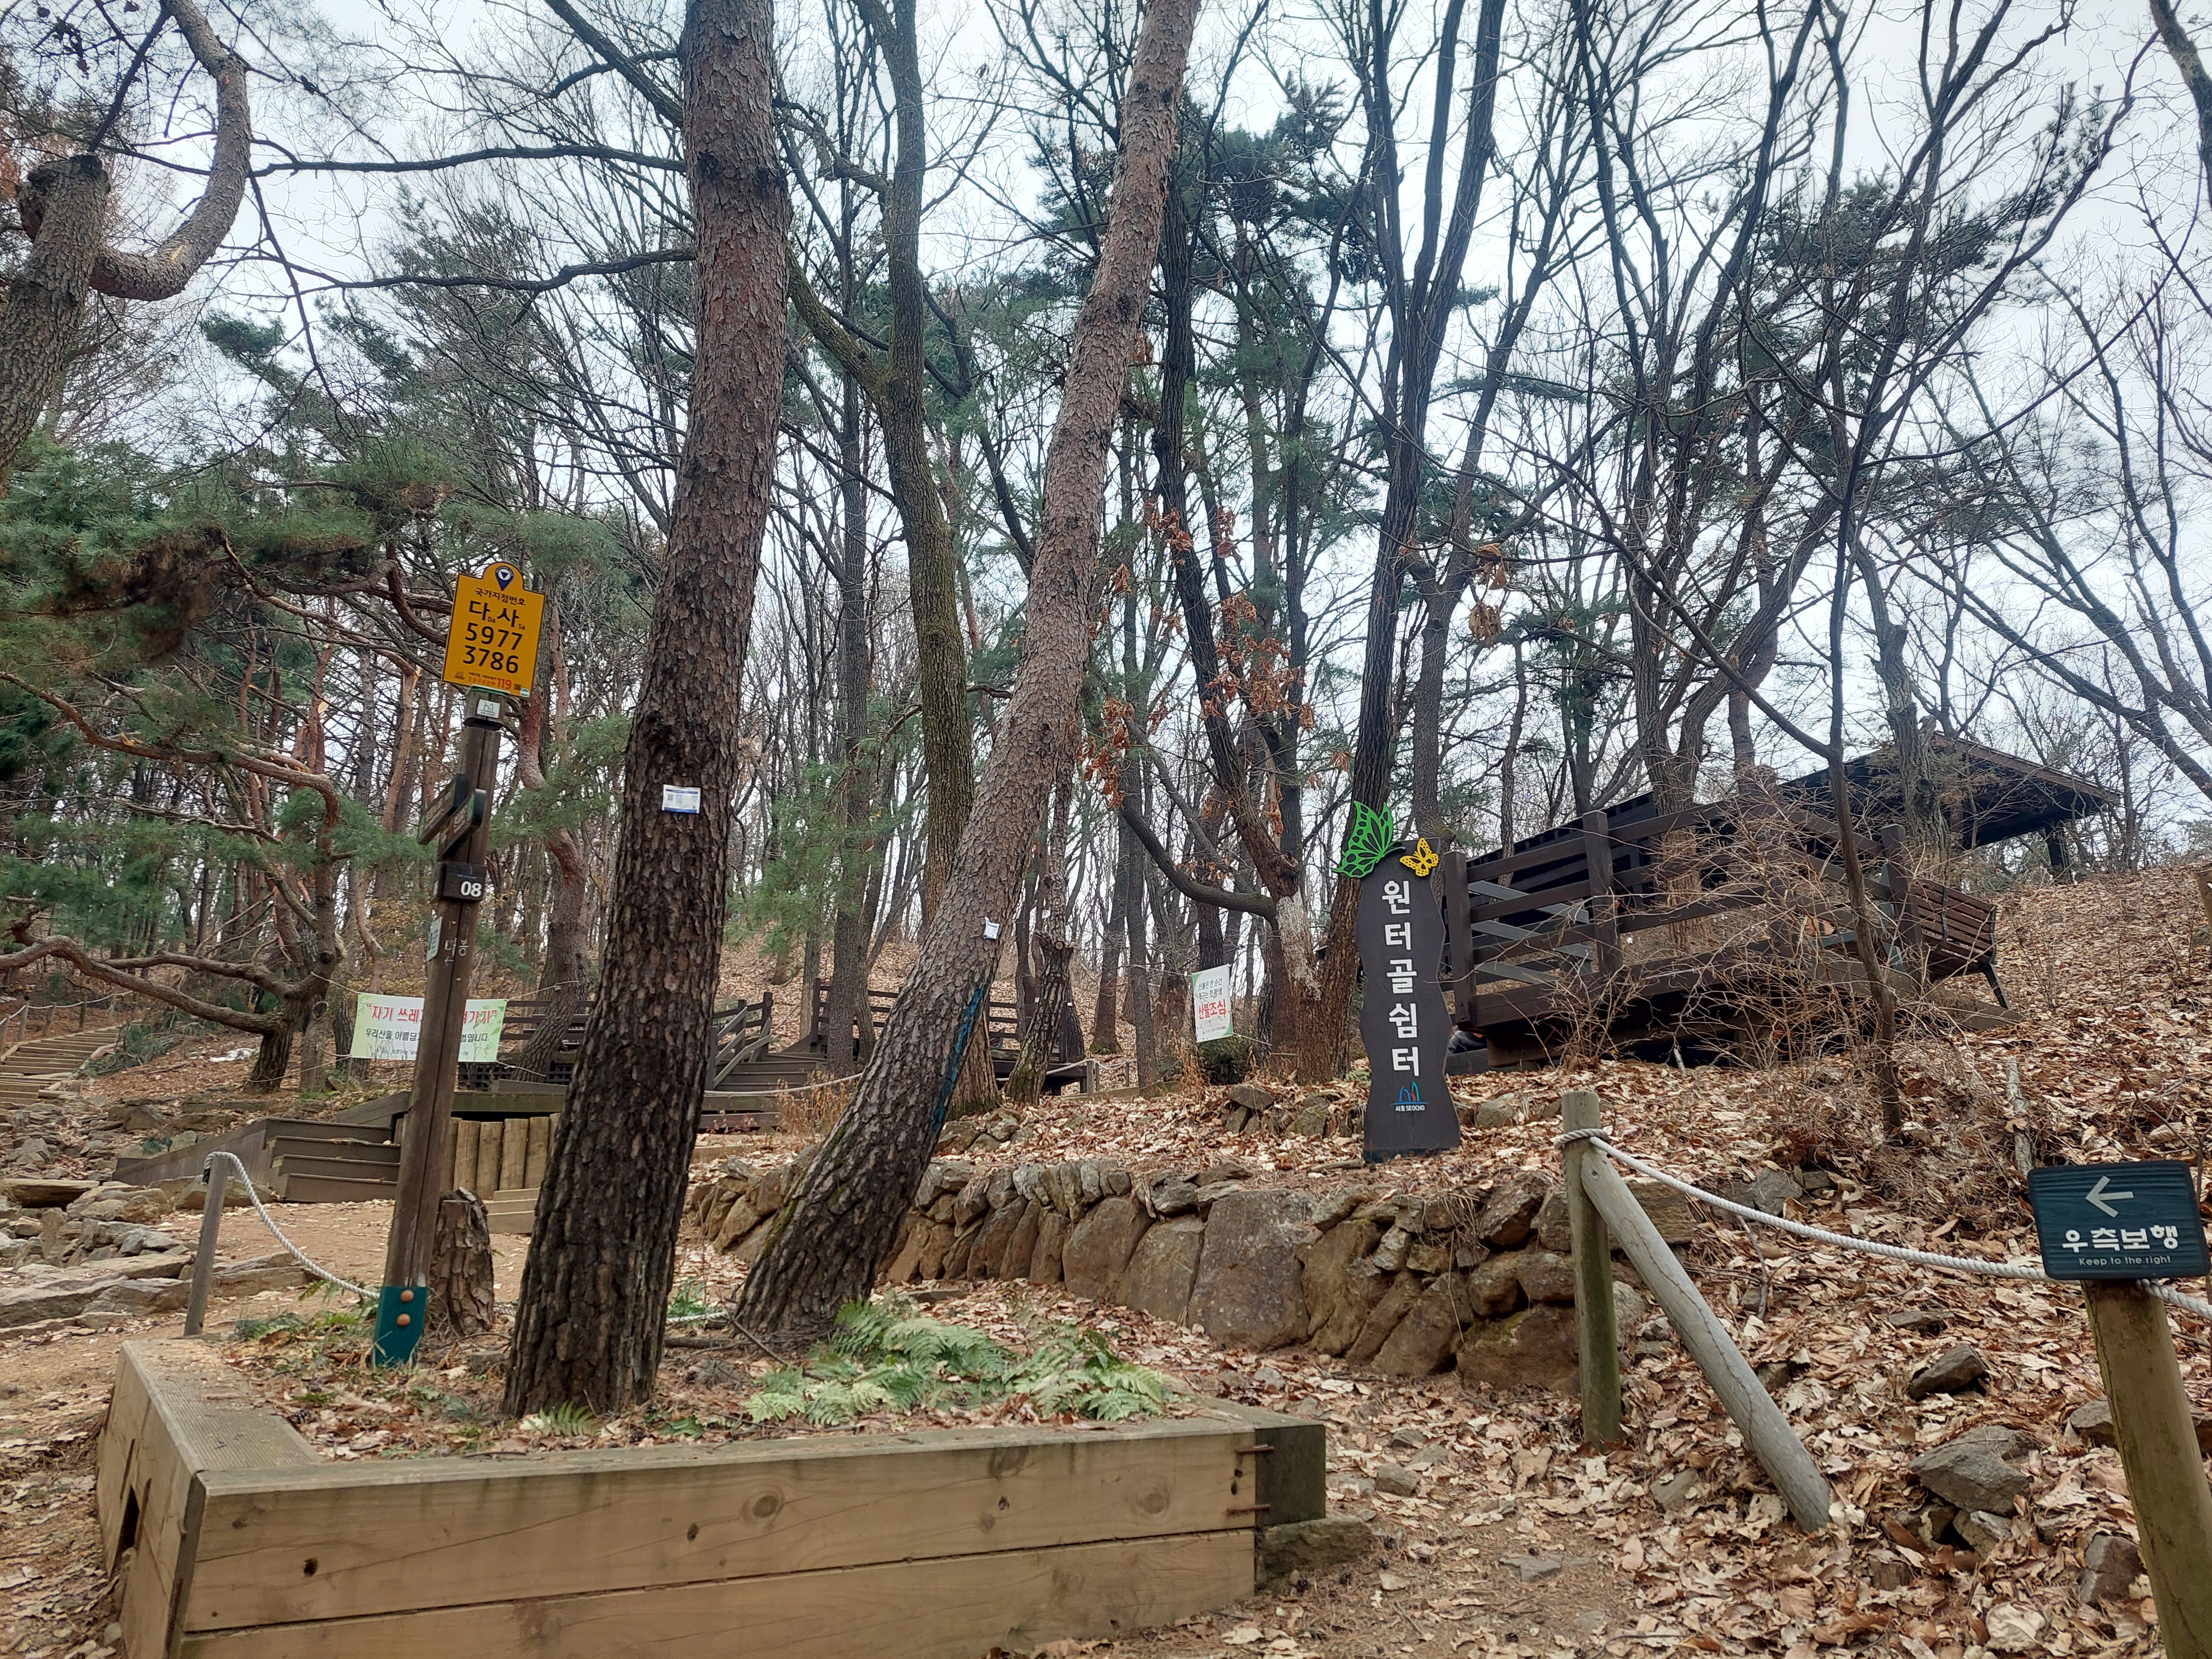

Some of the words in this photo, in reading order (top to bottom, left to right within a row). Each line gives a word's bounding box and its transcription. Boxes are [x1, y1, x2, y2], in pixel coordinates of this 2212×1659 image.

[475, 587, 526, 606] 국가지점번호
[469, 600, 491, 620] 다
[497, 608, 520, 628] 사
[465, 622, 523, 651] 5977
[463, 645, 518, 674] 3786
[498, 678, 512, 689] 119
[461, 881, 482, 897] 08
[1198, 981, 1209, 991] 산불은
[1198, 999, 1226, 1019] 산불조심
[395, 1031, 421, 1041] 아름답
[2061, 1224, 2179, 1253] 우측보행
[2079, 1257, 2108, 1266] Keep
[2111, 1256, 2122, 1264] to
[2125, 1256, 2142, 1264] the
[2146, 1255, 2171, 1265] right
